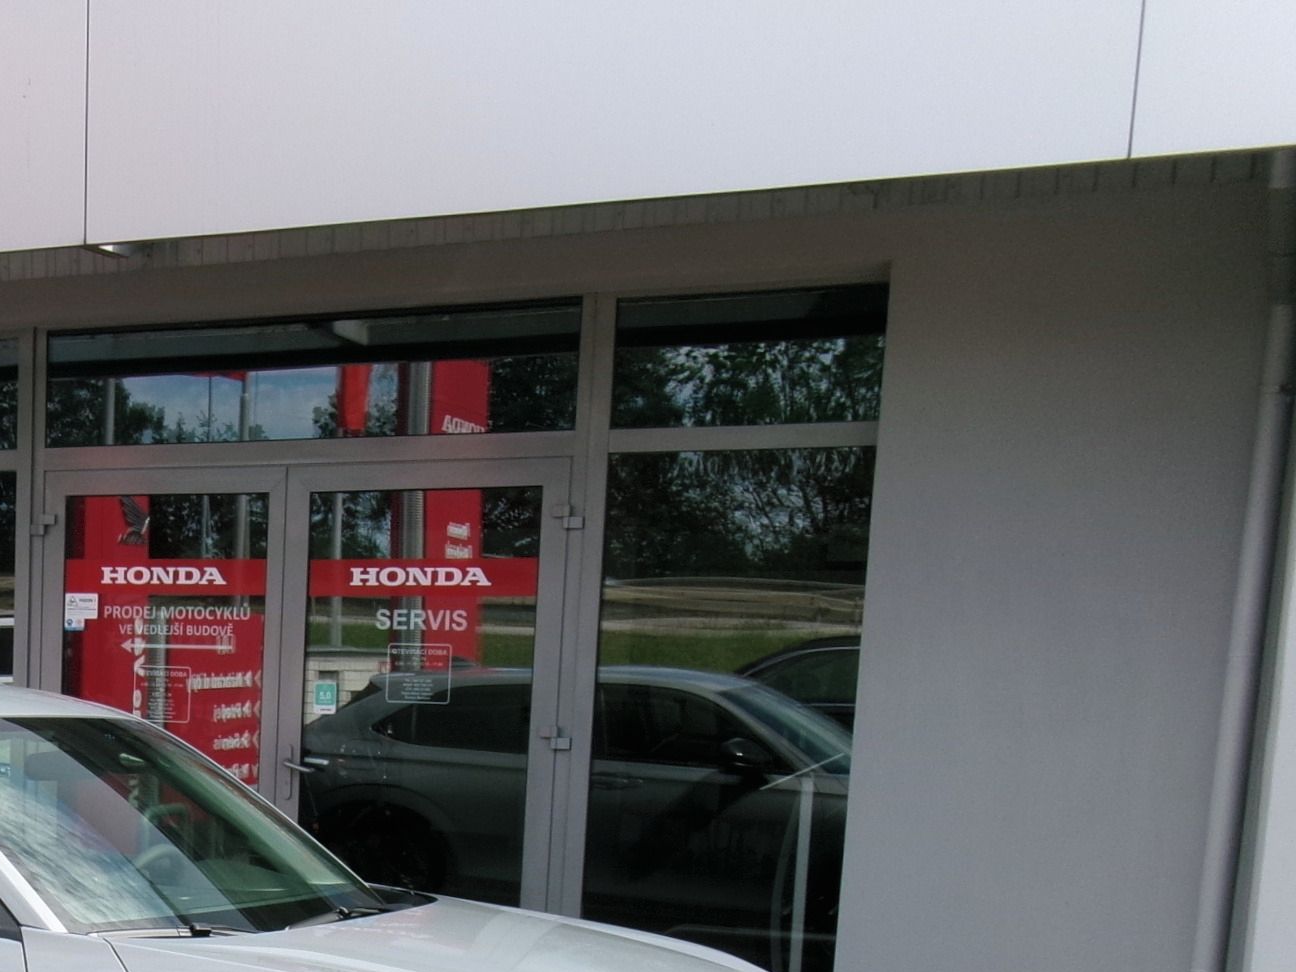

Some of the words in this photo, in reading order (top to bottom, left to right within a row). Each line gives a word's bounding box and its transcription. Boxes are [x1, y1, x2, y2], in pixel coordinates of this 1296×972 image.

[100, 566, 227, 585] HONDA
[349, 567, 492, 587] HONDA
[104, 605, 157, 620] PRODEJ
[160, 603, 251, 621] MOTOCYKLŮ
[375, 608, 468, 632] SERVIS
[119, 623, 134, 635] VE
[135, 622, 184, 636] VEDLEJŠÍ
[186, 623, 234, 637] BUDOVĚ
